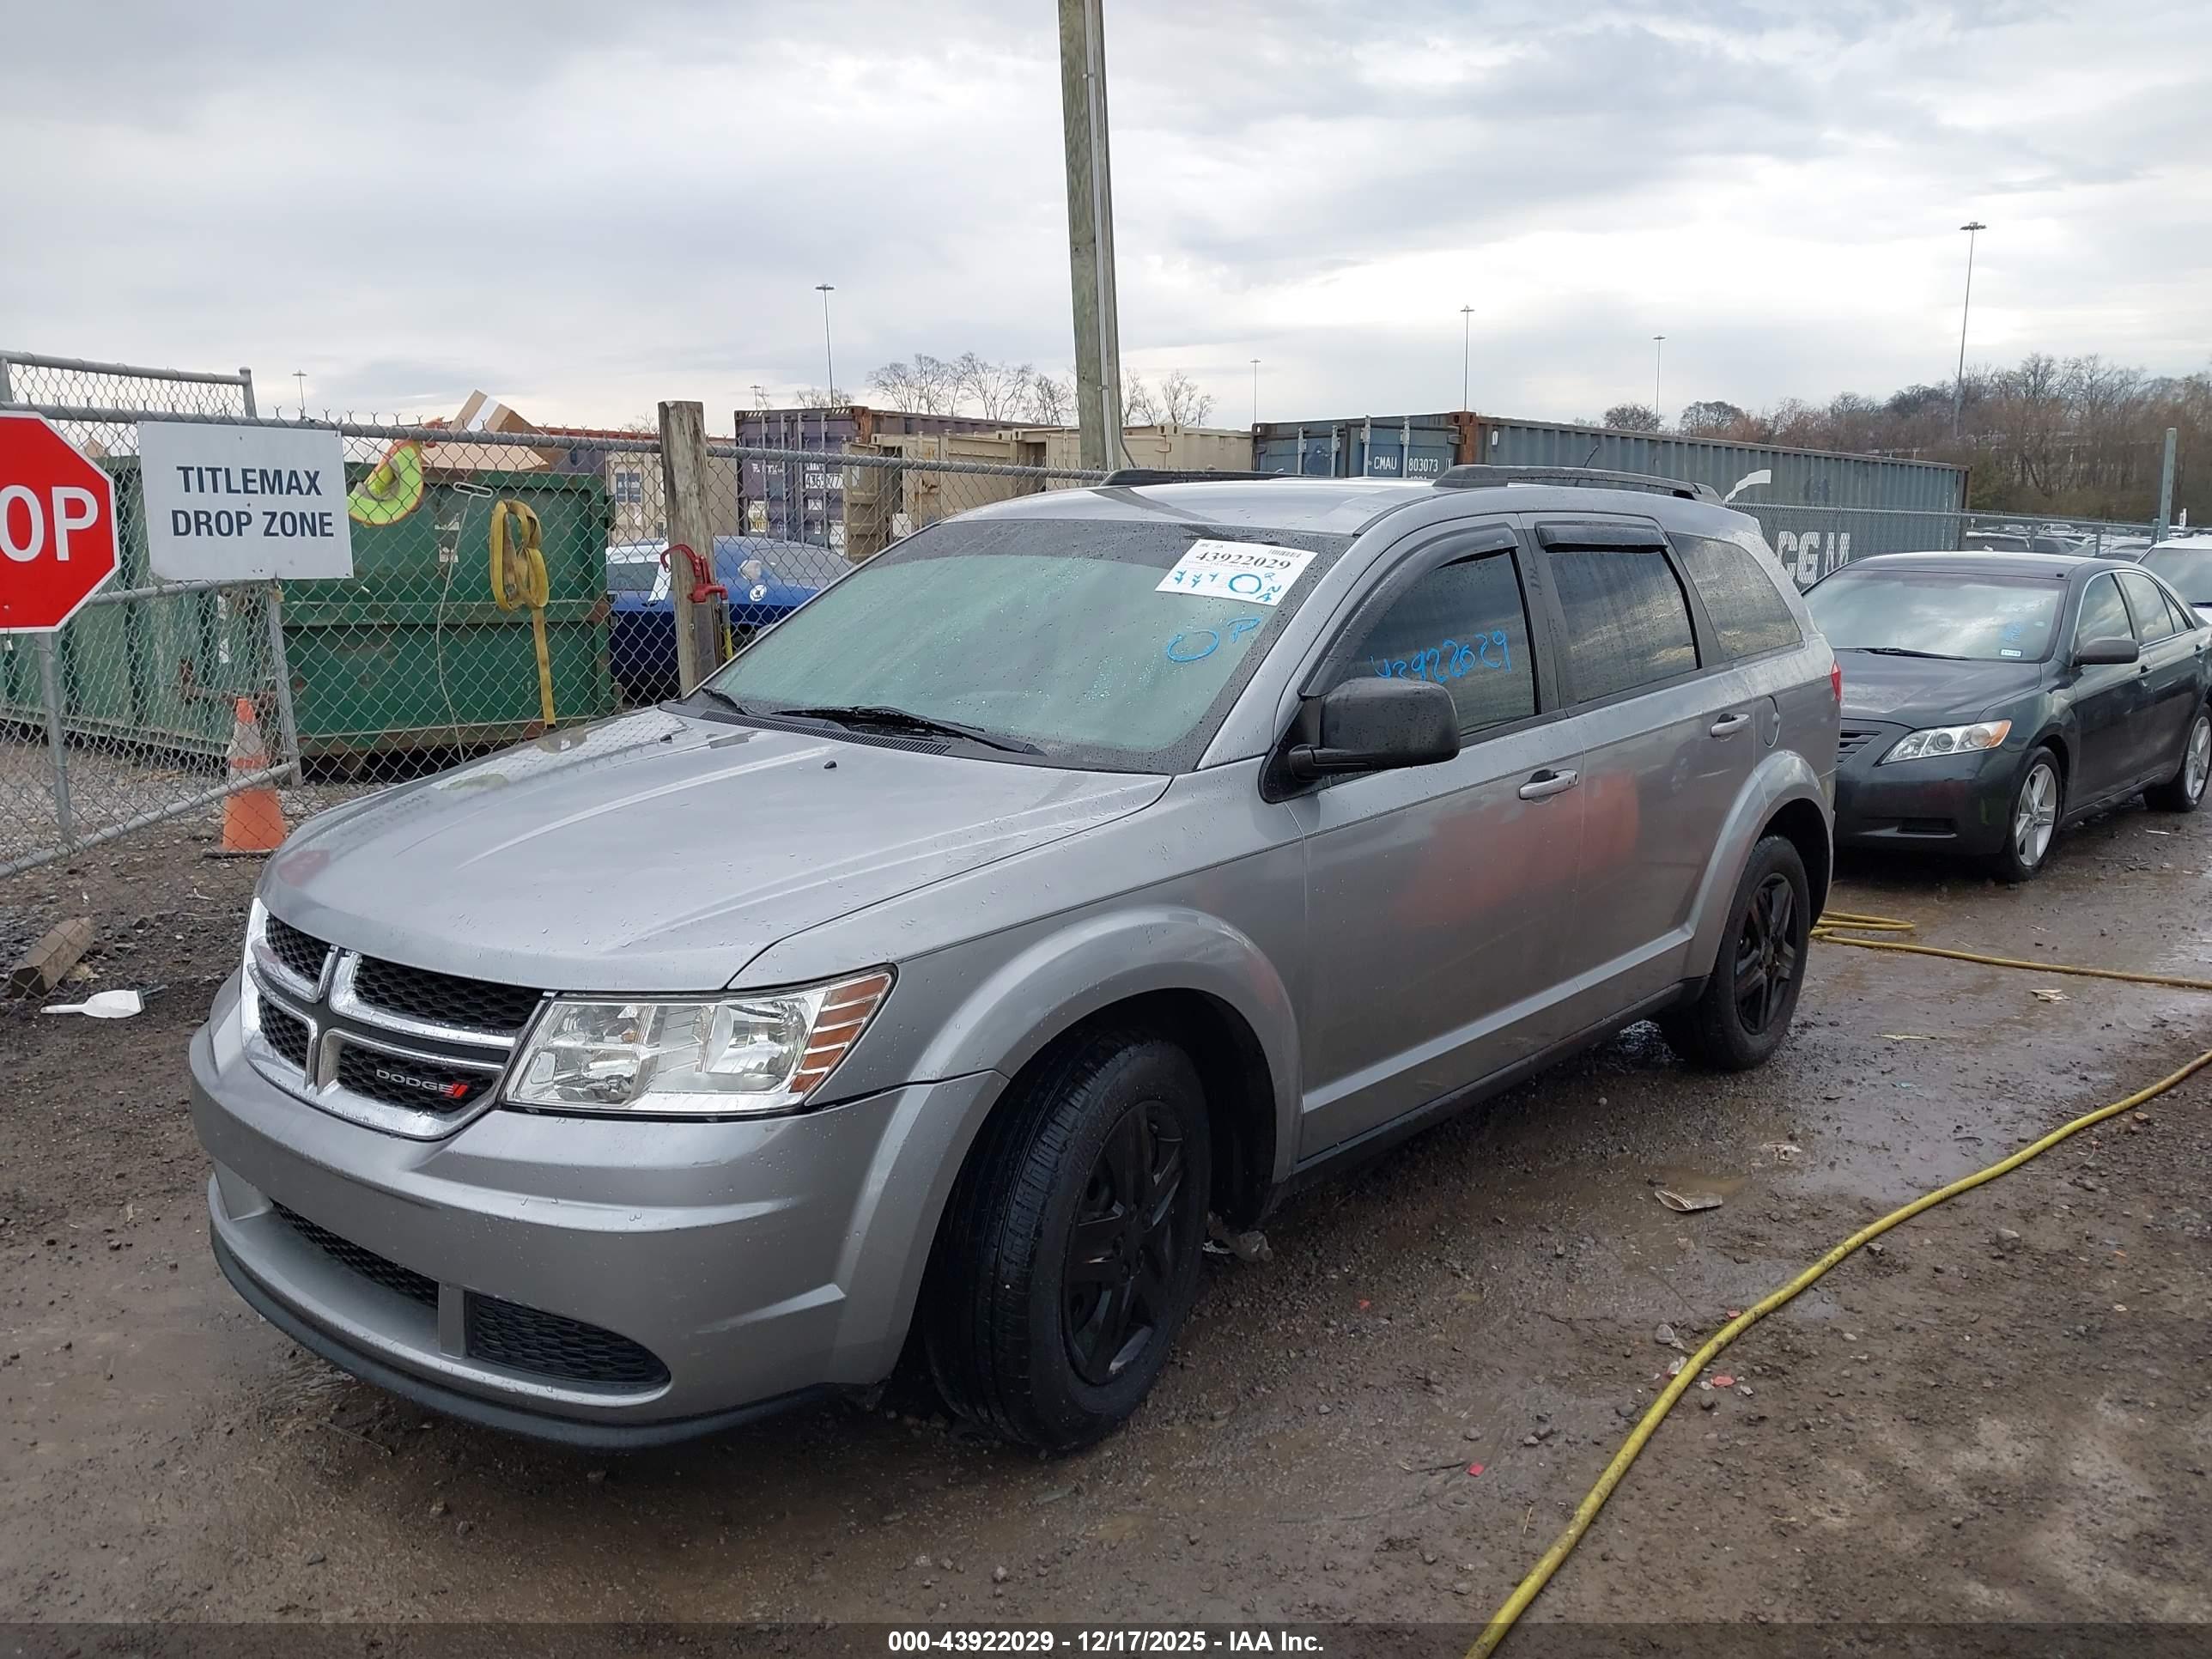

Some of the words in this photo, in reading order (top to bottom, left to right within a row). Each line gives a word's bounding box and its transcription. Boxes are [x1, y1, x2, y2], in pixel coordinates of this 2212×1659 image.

[1374, 456, 1397, 470] CMAU
[1408, 458, 1438, 472] 803073
[176, 465, 322, 496] TITLEMAX
[172, 509, 252, 537] DROP
[263, 511, 335, 538] ZONE
[1195, 550, 1291, 570] 43922029
[376, 1069, 455, 1095] DODGE
